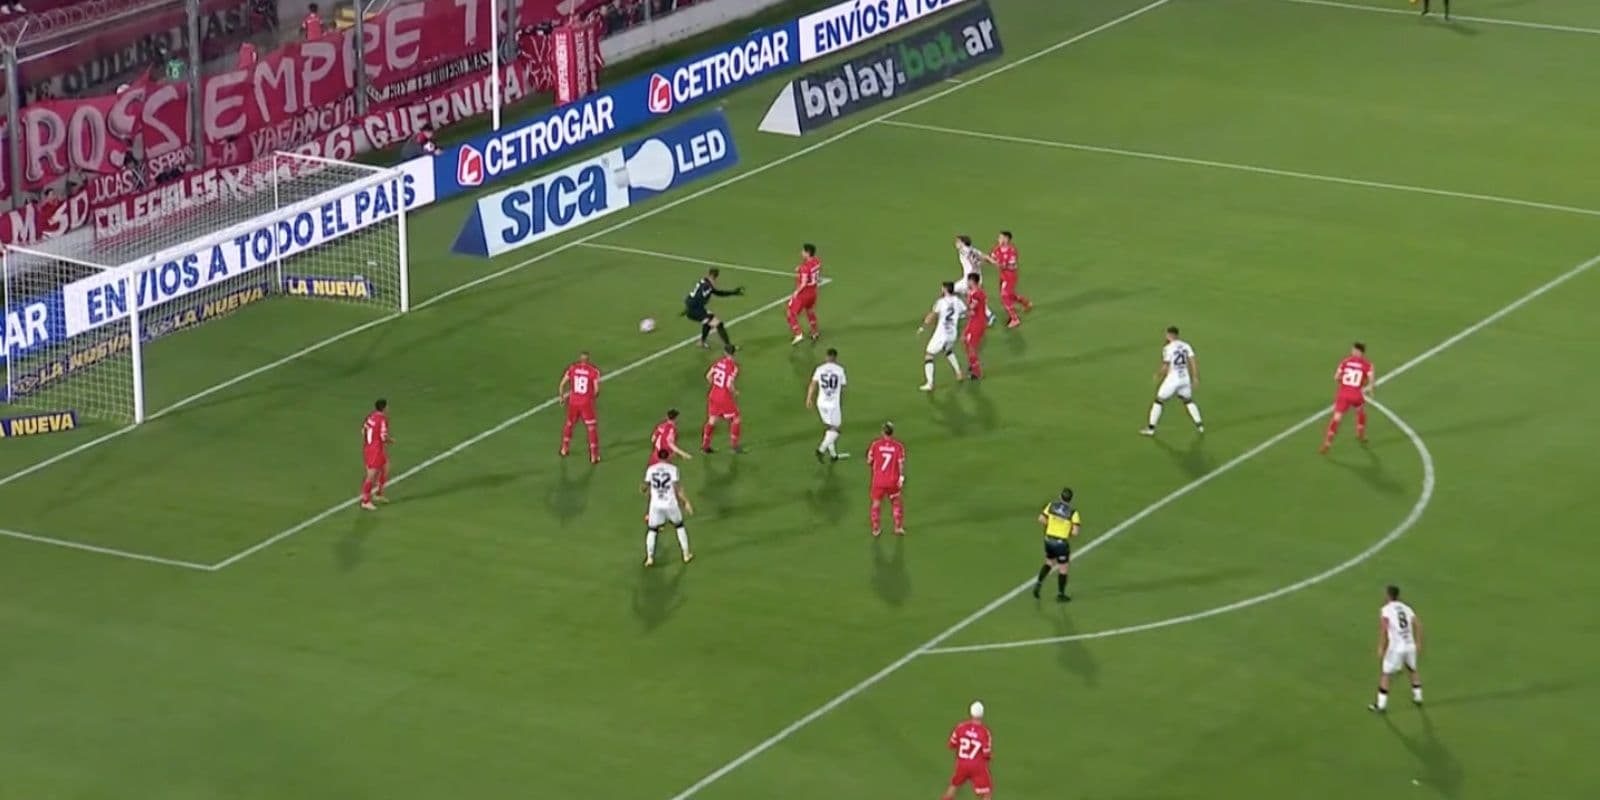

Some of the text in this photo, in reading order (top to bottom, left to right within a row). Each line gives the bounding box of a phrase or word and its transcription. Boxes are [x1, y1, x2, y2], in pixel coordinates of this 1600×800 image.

[814, 0, 890, 53] ENVÍOS
[673, 30, 789, 102] CETROGAR
[484, 95, 615, 175] CETROGAR
[675, 128, 726, 174] LED
[208, 244, 228, 280] A
[234, 211, 314, 269] TODO
[320, 199, 349, 238] EL
[288, 279, 368, 298] LA NUEVA
[202, 287, 265, 317] NUEVA
[945, 307, 955, 322] 2
[0, 302, 49, 356] AR
[69, 332, 131, 370] NUEVA
[573, 375, 589, 395] 18
[820, 373, 838, 390] 50
[1342, 368, 1363, 387] 20
[11, 412, 75, 436] NUEVA
[881, 452, 893, 472] 7
[651, 472, 672, 491] 52
[958, 737, 982, 760] 27
